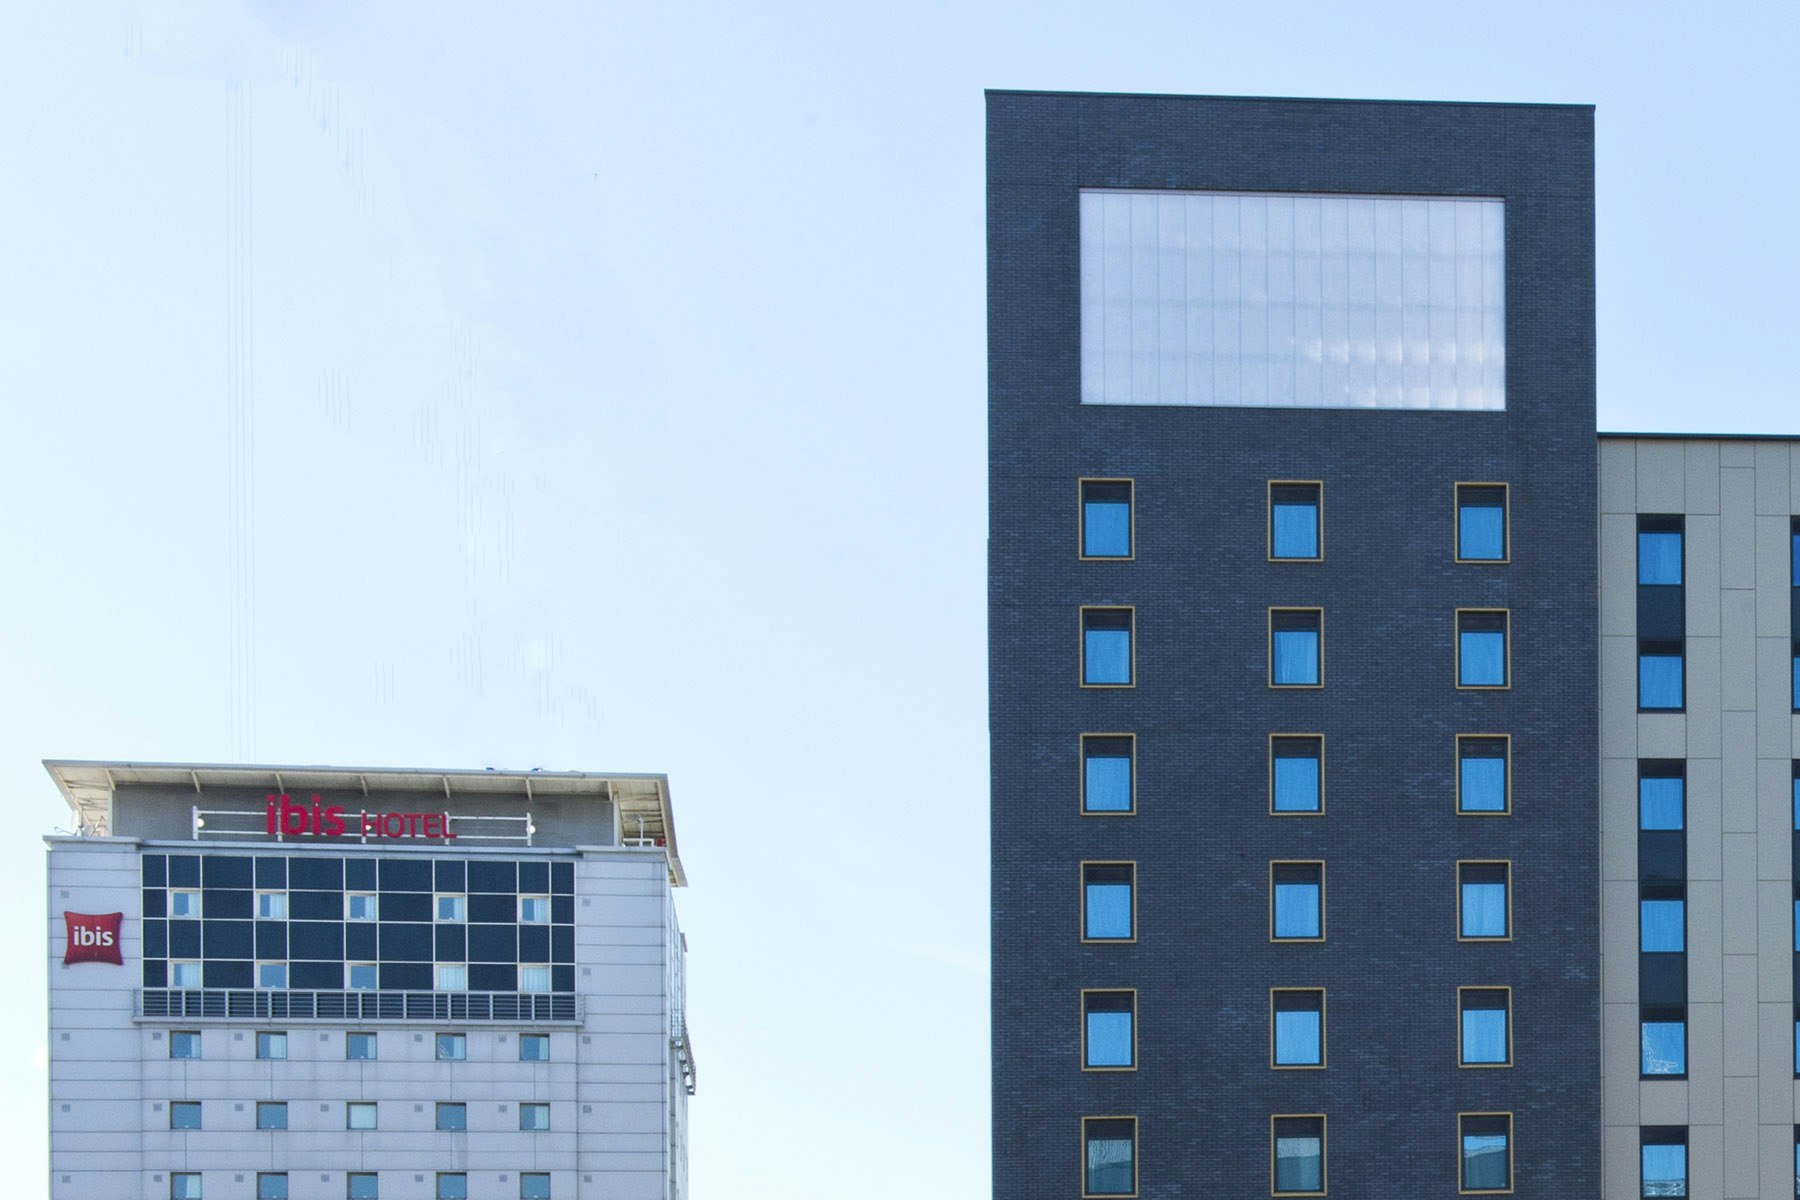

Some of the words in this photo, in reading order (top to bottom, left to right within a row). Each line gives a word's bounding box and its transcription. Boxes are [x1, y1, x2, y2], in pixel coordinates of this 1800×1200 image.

[266, 794, 346, 836] ibis
[361, 811, 457, 839] HOTEL
[73, 925, 114, 947] ibis
